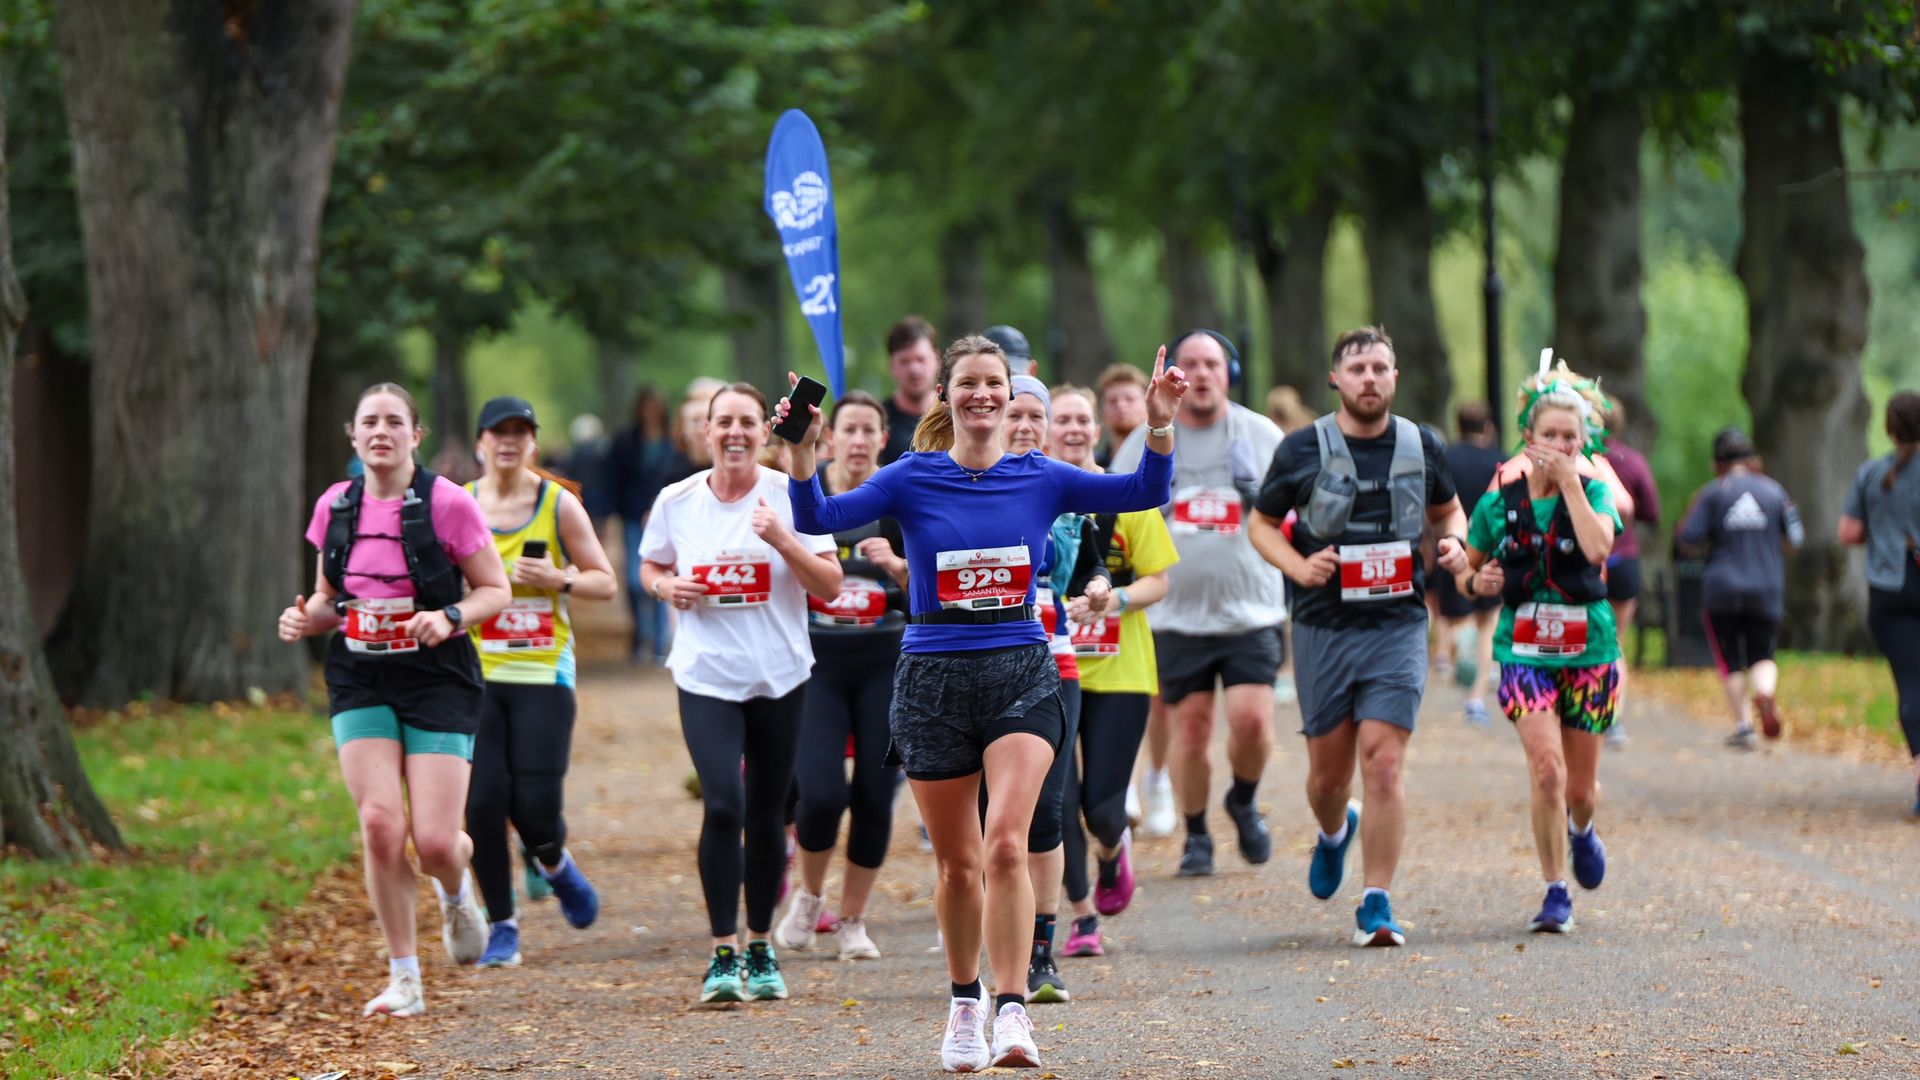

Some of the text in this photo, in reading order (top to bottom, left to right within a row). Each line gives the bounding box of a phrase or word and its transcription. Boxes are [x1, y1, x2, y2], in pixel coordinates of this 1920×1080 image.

[706, 565, 756, 585] 442
[957, 568, 1012, 590] 929
[1361, 559, 1397, 580] 515
[962, 586, 1007, 597] SAMANTHA
[1536, 619, 1565, 639] 39
